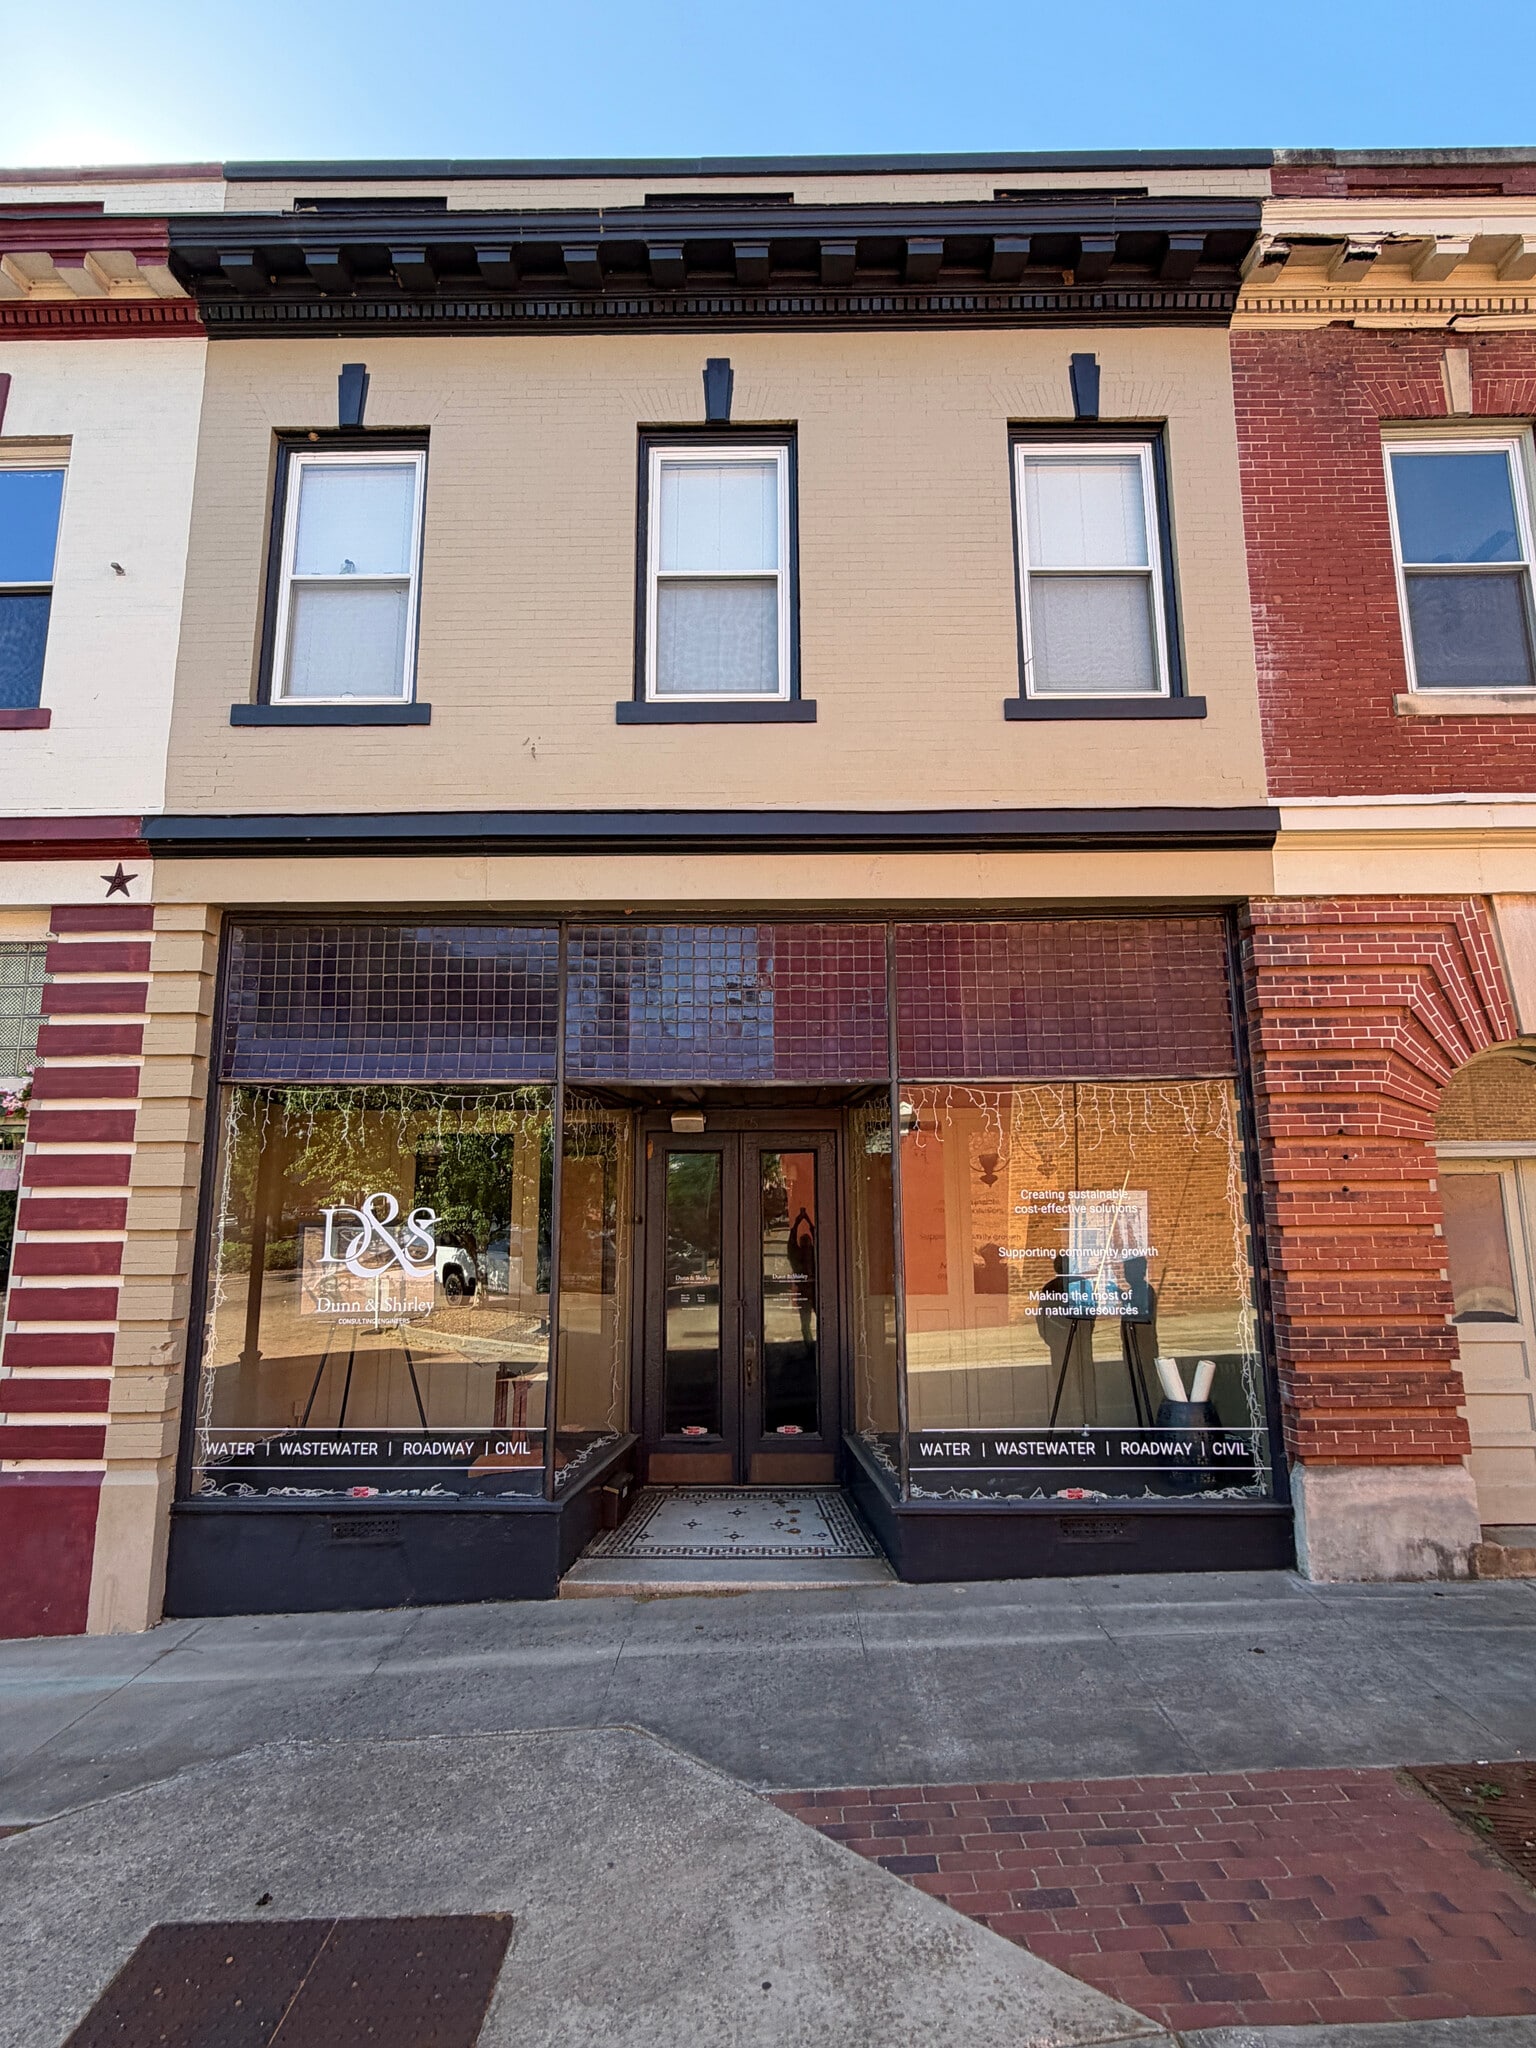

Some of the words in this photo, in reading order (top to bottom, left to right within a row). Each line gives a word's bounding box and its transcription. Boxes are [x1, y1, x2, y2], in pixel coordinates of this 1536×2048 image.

[1020, 1189, 1065, 1201] Creating
[1014, 1203, 1087, 1214] cost-effective
[1089, 1203, 1138, 1214] solutions
[316, 1192, 442, 1278] D&S
[998, 1247, 1056, 1259] Supporting
[1059, 1247, 1118, 1259] community
[1121, 1246, 1158, 1258] growth
[1029, 1290, 1068, 1303] Making
[1071, 1290, 1088, 1301] the
[1091, 1291, 1118, 1301] most
[1121, 1289, 1133, 1301] of
[316, 1297, 360, 1313] Dunn
[365, 1298, 378, 1313] &
[384, 1296, 434, 1317] Shirley
[1024, 1306, 1042, 1316] our
[1045, 1304, 1083, 1316] natural
[1085, 1306, 1139, 1316] resources
[206, 1442, 255, 1456] WATER
[280, 1442, 378, 1456] WASTEWATER
[403, 1441, 474, 1455] ROADWAY
[495, 1441, 531, 1455] CIVIL
[919, 1442, 971, 1456] WATER
[995, 1441, 1096, 1456] WASTEWATER
[1120, 1441, 1193, 1456] ROADWAY
[1212, 1441, 1249, 1456] CIVIL
